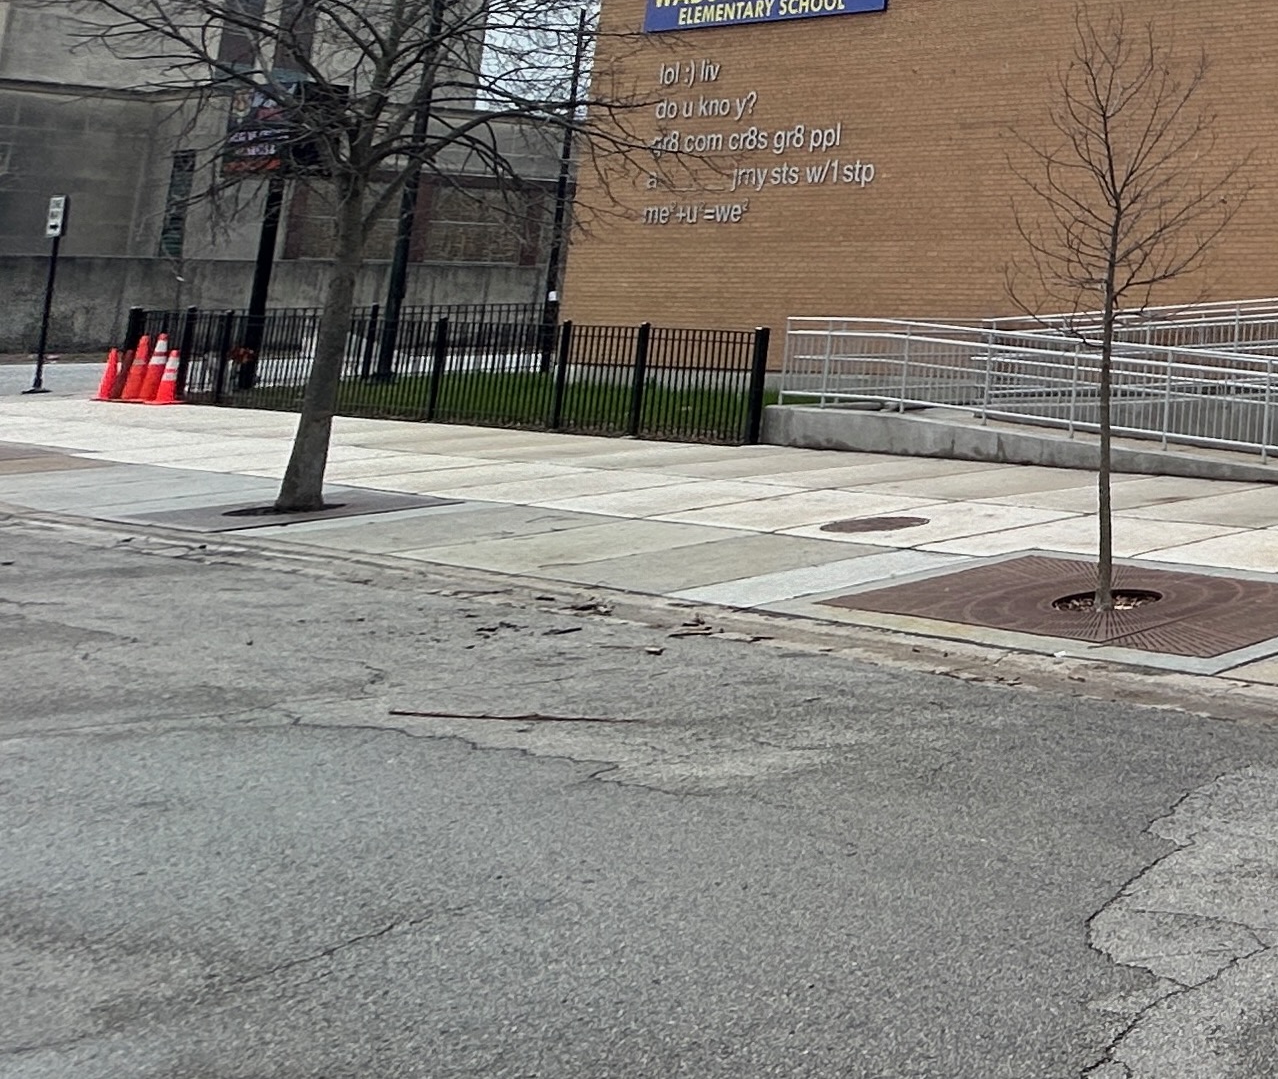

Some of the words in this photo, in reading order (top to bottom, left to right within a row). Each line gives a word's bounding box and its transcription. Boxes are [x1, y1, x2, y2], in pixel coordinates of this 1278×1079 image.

[660, 61, 681, 85] lol
[700, 58, 721, 83] liv
[656, 99, 678, 119] do
[682, 99, 694, 118] u
[699, 96, 731, 117] kno
[734, 91, 758, 121] y?
[684, 133, 723, 153] com
[728, 126, 768, 151] cr8s
[772, 125, 805, 155] gr8
[809, 122, 842, 153] ppl
[770, 162, 800, 185] sts
[806, 159, 840, 185] w/1
[842, 160, 875, 188] stp
